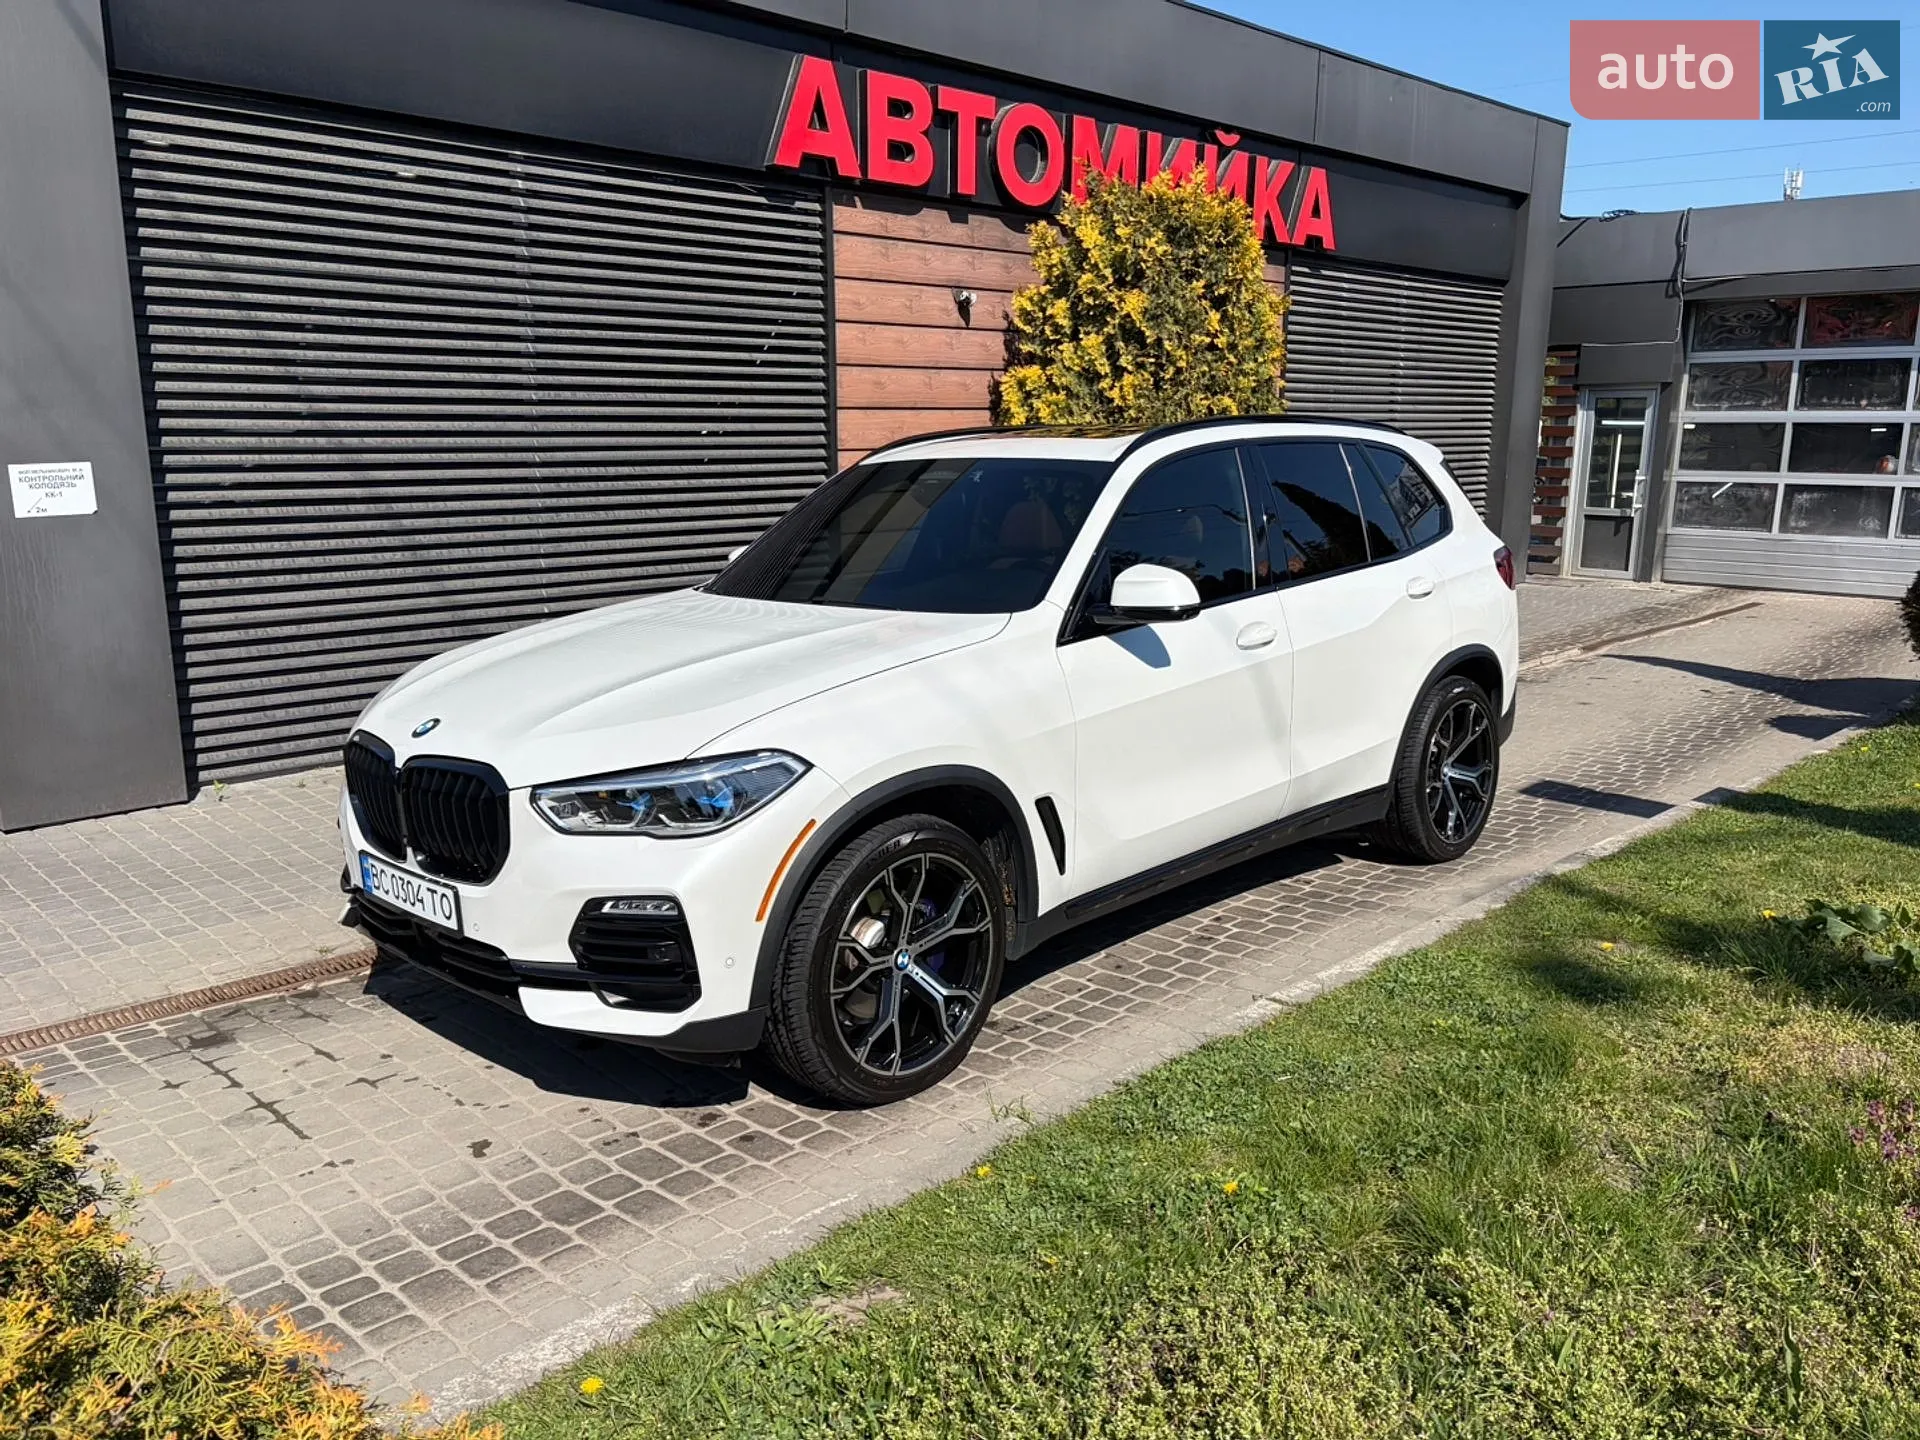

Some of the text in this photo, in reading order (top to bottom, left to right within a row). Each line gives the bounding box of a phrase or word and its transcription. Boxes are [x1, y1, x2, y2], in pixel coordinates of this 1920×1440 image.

[770, 54, 1336, 250] АВТОМИЙКА
[370, 863, 453, 921] BC 0304 TO
